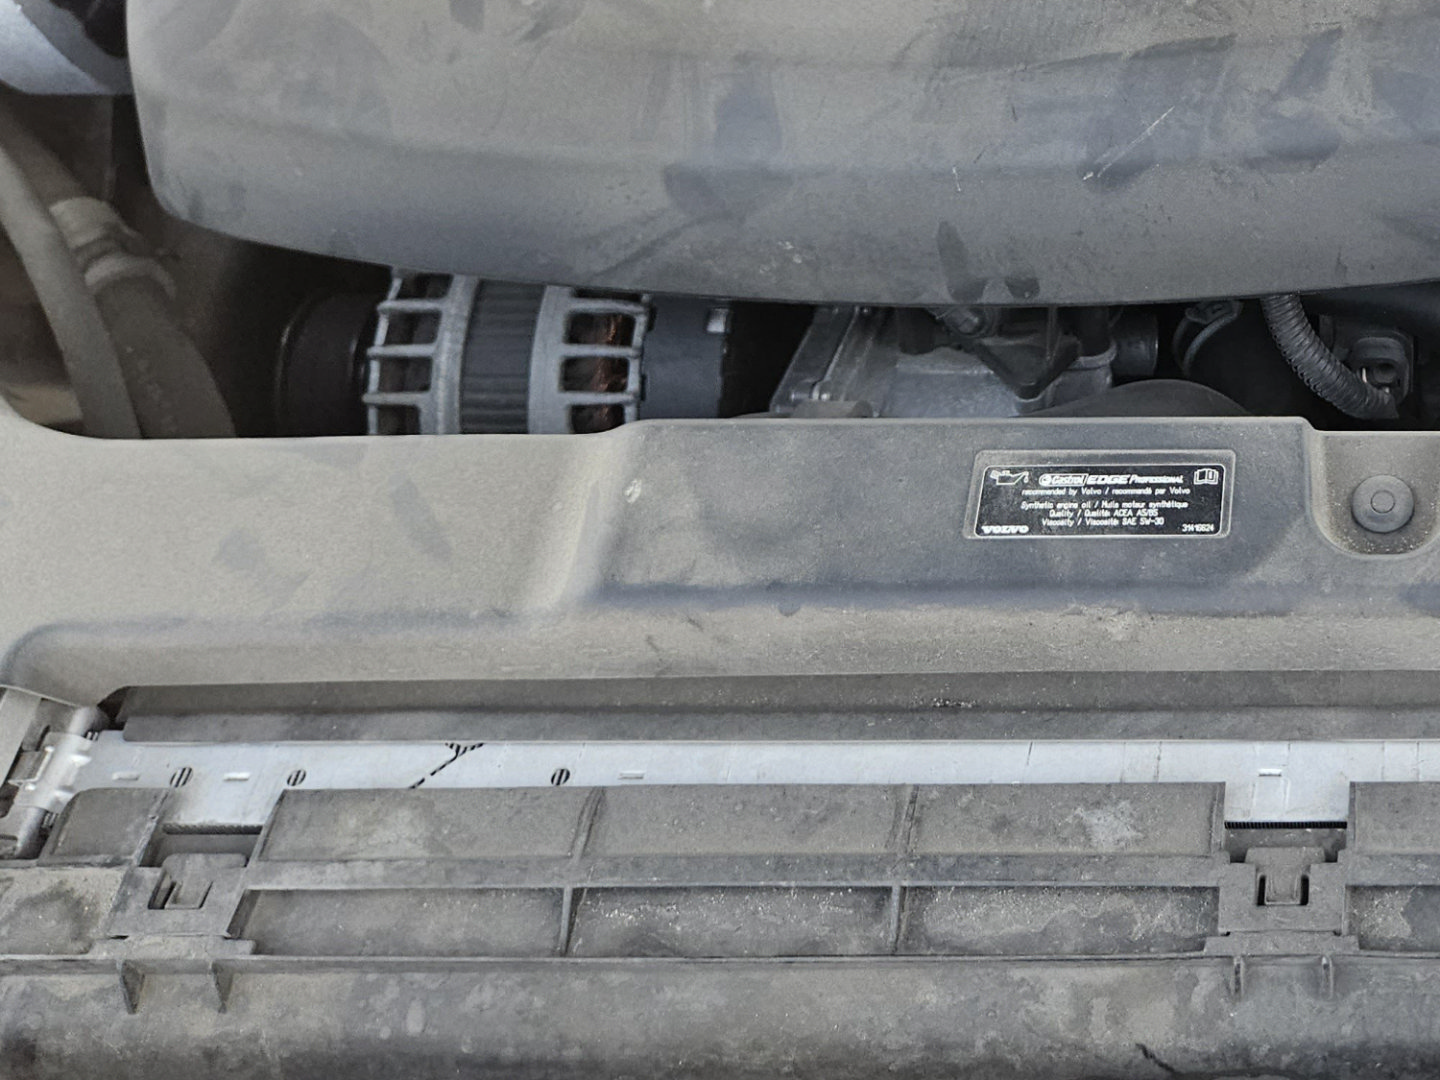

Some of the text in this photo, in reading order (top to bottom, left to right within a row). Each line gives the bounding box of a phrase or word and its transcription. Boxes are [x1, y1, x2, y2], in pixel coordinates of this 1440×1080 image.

[1087, 474, 1130, 485] EDGE
[1021, 488, 1066, 496] recommended
[1069, 488, 1078, 497] by
[1081, 487, 1102, 495] Volvo
[1169, 487, 1191, 495] Volvo
[1020, 501, 1054, 510] Synthetic
[1056, 502, 1079, 510] engine
[1081, 501, 1091, 509] oil
[1122, 501, 1146, 509] moteur
[1049, 509, 1074, 518] Quality
[1113, 509, 1133, 517] ACEA
[1042, 518, 1074, 527] Viscosity
[1122, 517, 1137, 525] SAE
[1139, 517, 1165, 525] 5W-30
[981, 525, 1030, 534] VOLVO
